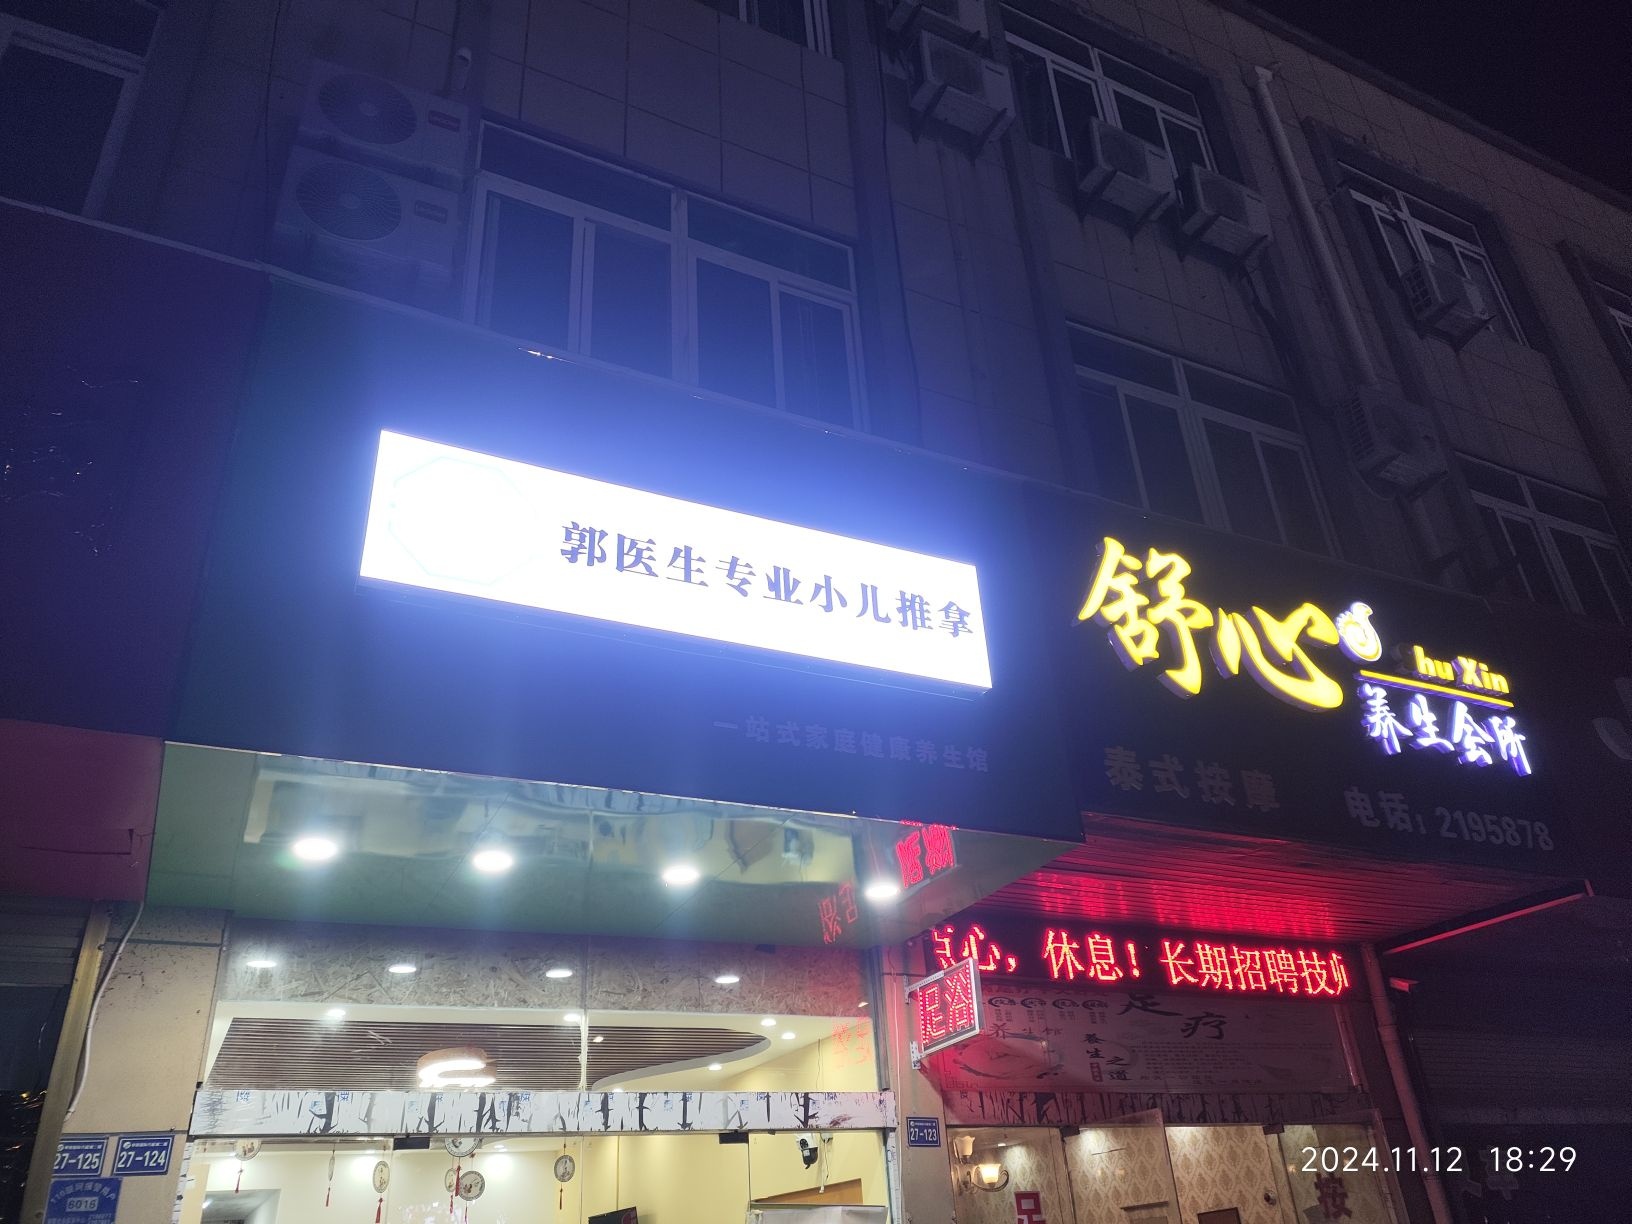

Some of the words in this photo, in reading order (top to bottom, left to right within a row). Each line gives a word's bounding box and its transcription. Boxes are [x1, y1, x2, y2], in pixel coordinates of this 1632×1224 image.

[560, 521, 975, 639] 郭医生专业小儿推拿
[1077, 536, 1345, 712] 舒心
[711, 714, 989, 772] 一站式家庭健康养生馆
[1359, 683, 1533, 776] 养生会所
[1103, 745, 1281, 813] 泰式按摩
[921, 970, 972, 1041] 足浴
[54, 1153, 101, 1169] 27-125
[117, 1150, 165, 1168] 27-124
[910, 1127, 938, 1142] 27-123
